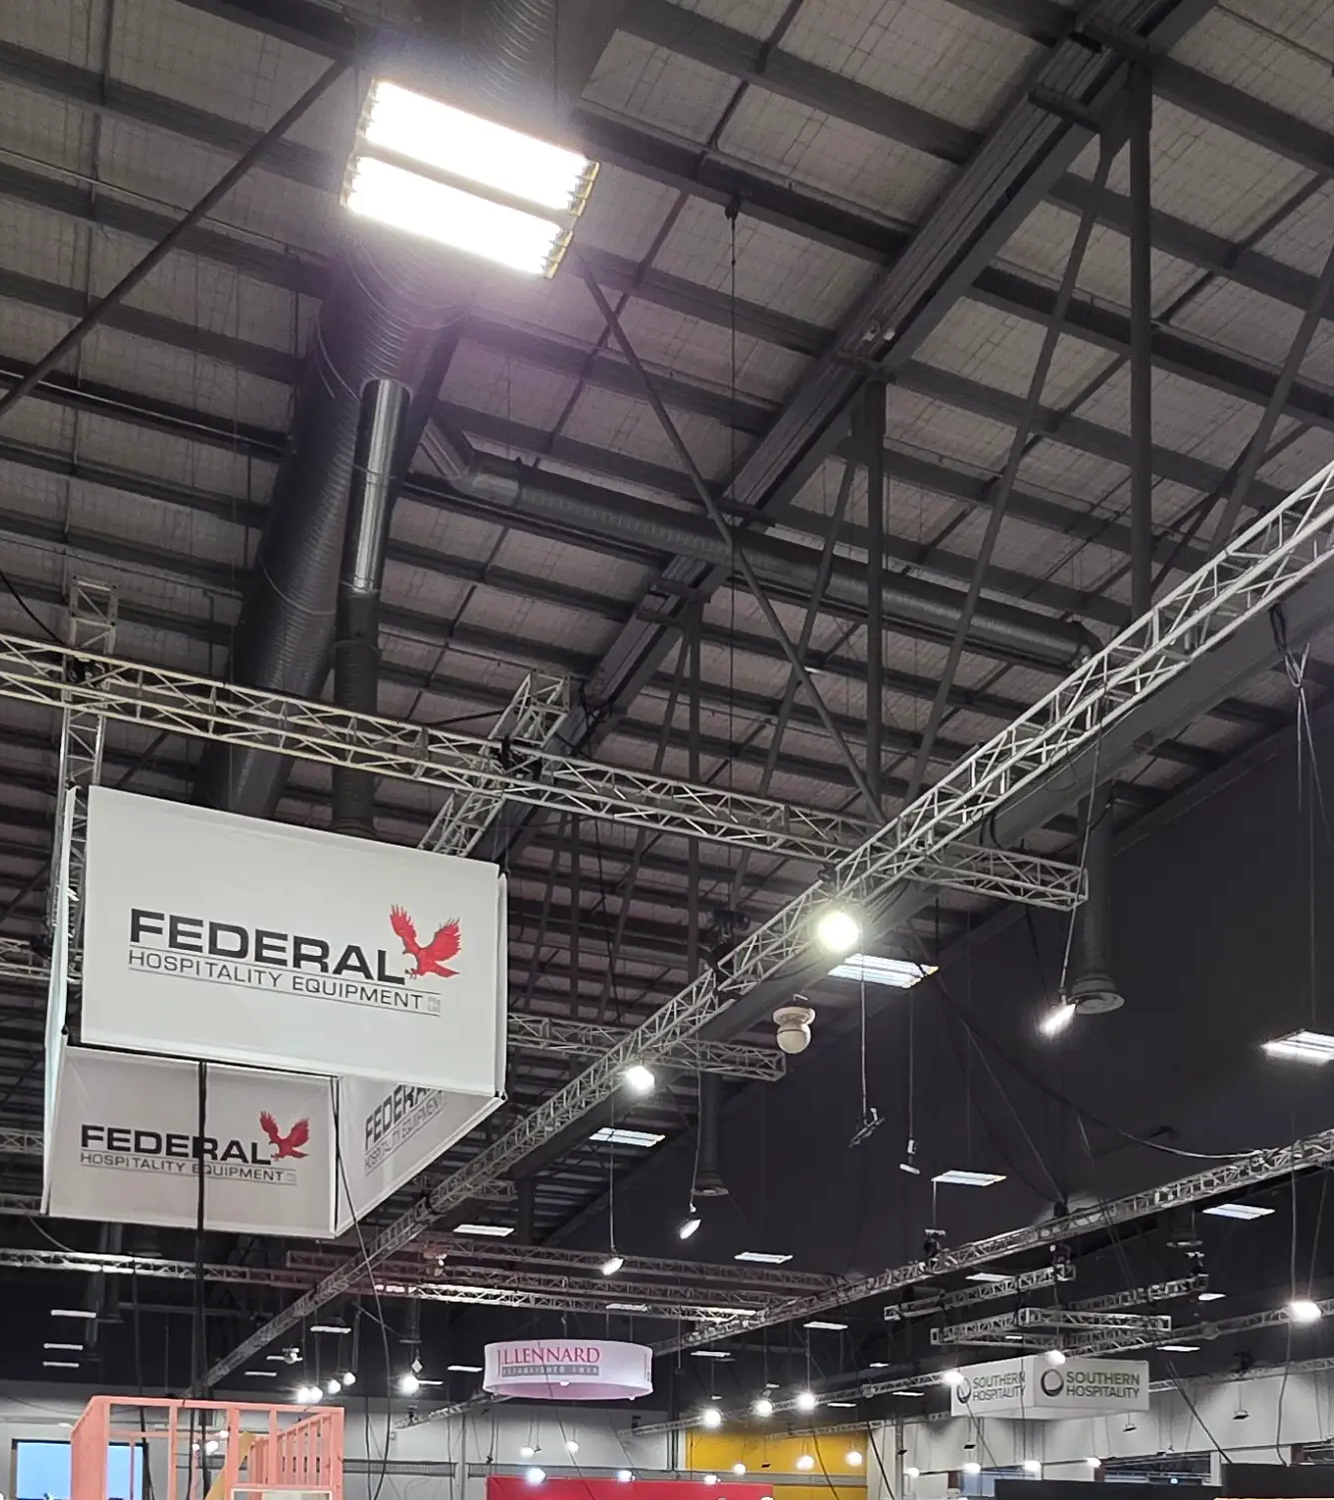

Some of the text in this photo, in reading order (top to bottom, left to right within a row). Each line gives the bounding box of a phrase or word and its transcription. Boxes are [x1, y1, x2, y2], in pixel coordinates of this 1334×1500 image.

[130, 908, 405, 985] FEDERAL
[128, 949, 282, 987] HOSPITALITY
[292, 976, 423, 1009] EQUIPMENT
[81, 1124, 271, 1165] FEDERAL
[80, 1152, 185, 1172] HOSPITALITY
[192, 1164, 284, 1182] EQUIPMENT
[973, 1371, 1025, 1389] SOUTHERN
[1066, 1371, 1140, 1385] SOUTHERN
[1066, 1386, 1140, 1398] HOSPITALITY
